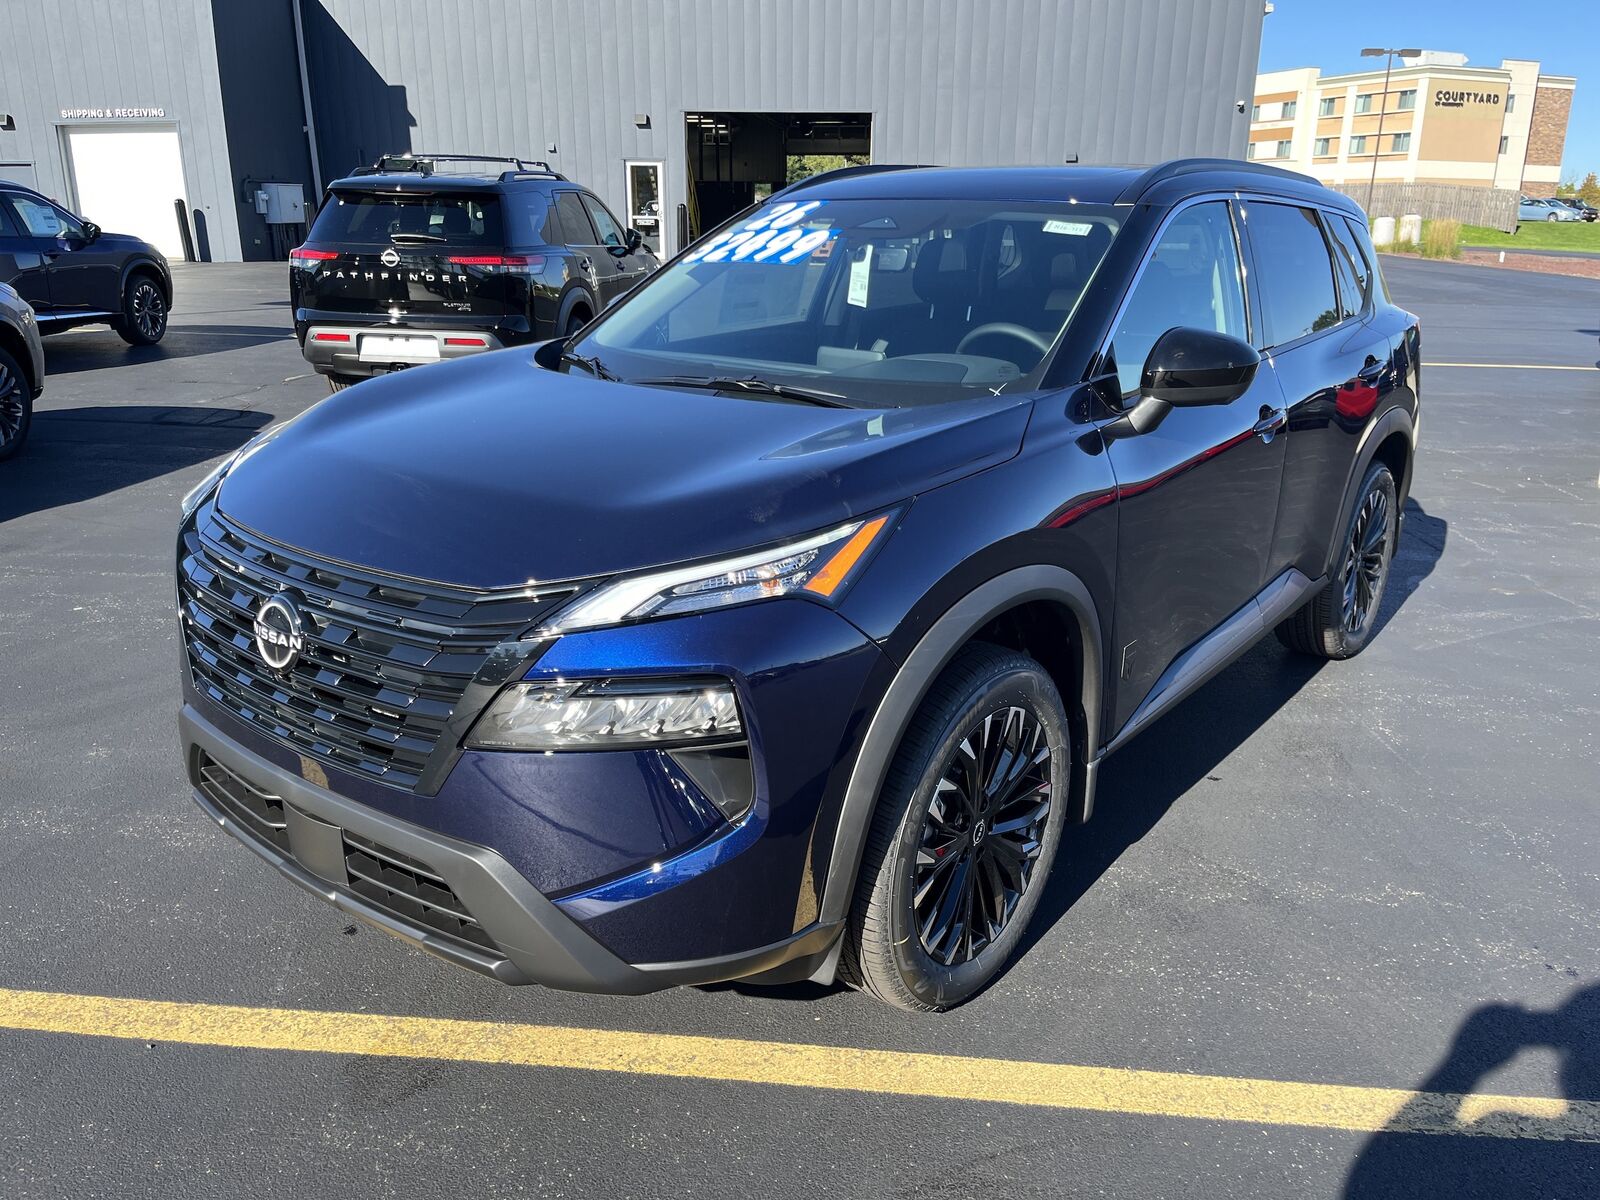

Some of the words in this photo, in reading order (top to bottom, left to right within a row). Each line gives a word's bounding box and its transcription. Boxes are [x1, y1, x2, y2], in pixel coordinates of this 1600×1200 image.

[1436, 90, 1500, 105] COURTYARD
[61, 109, 104, 118] SHIPPING
[106, 109, 113, 118] &
[115, 108, 165, 117] RECEIVING
[322, 271, 468, 283] PATHFINDER
[253, 620, 302, 650] NISSAN
